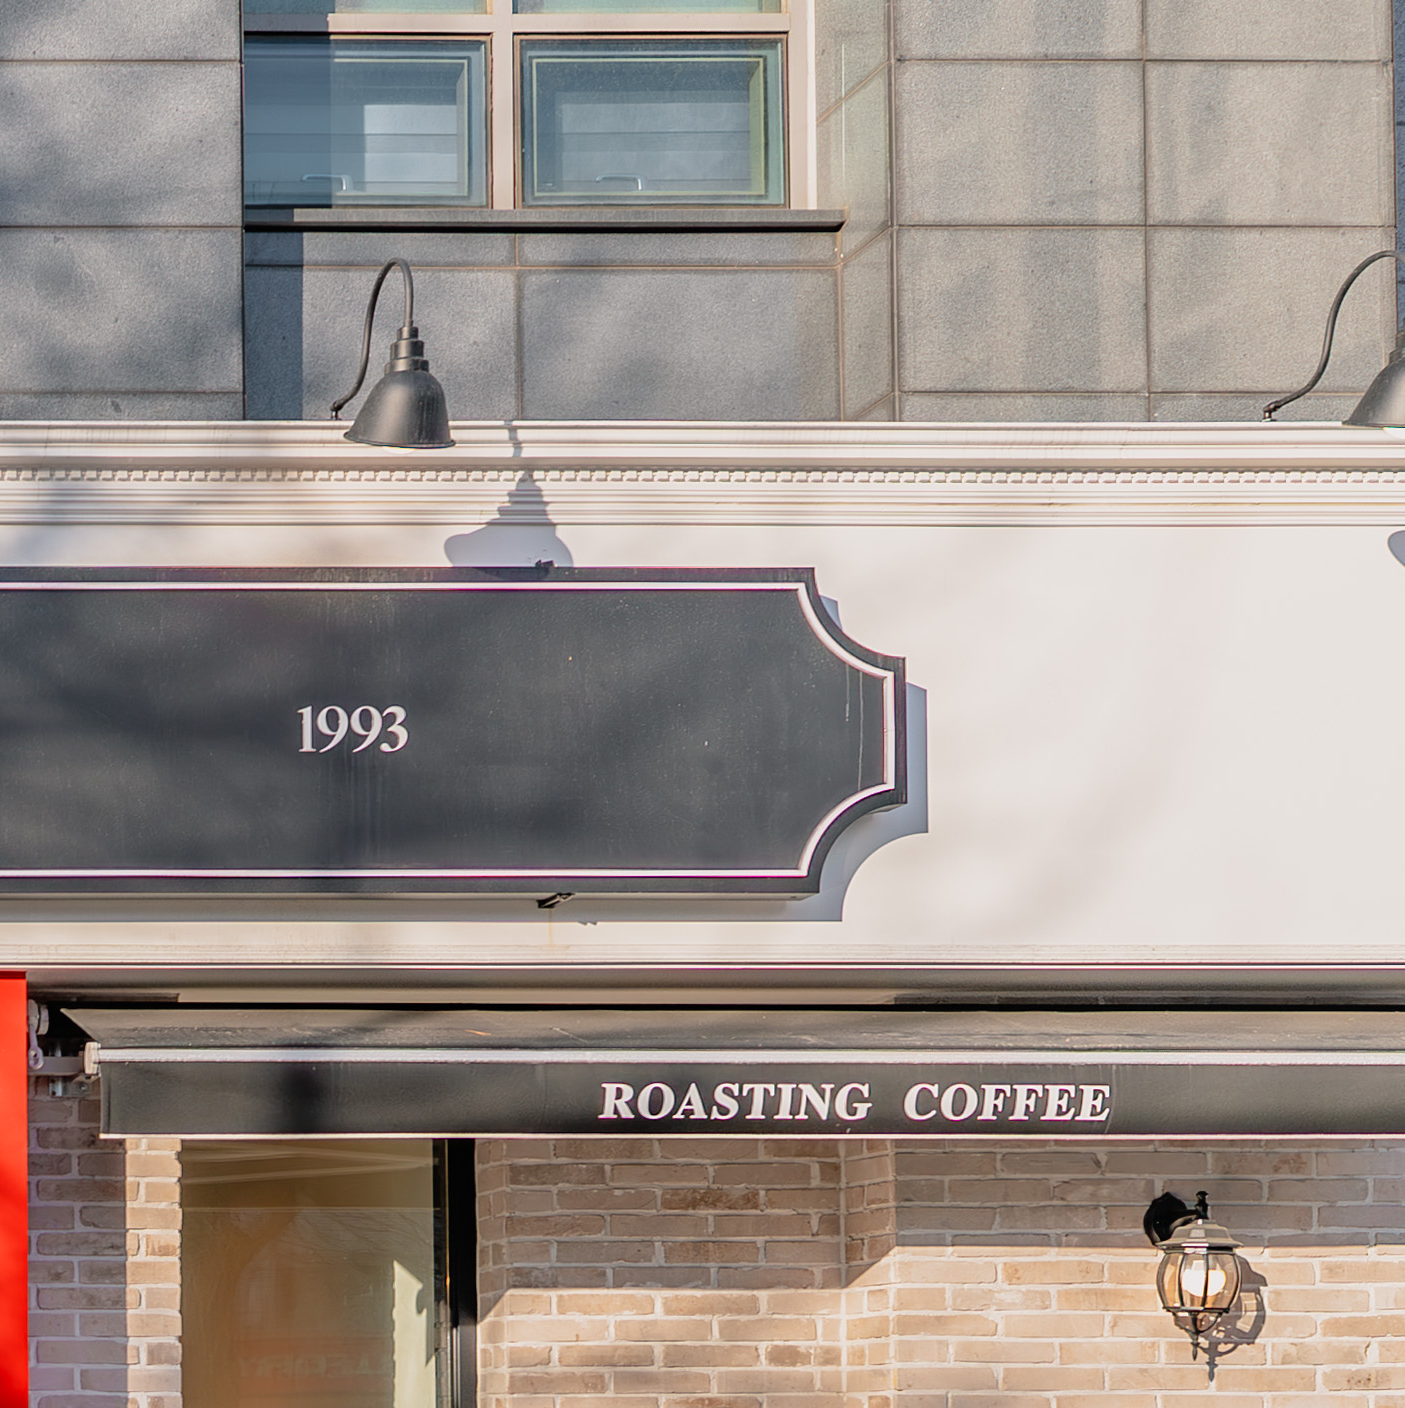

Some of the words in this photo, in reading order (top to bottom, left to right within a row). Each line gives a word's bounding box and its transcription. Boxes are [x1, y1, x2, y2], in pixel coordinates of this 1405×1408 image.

[296, 703, 408, 758] 1993
[596, 1081, 873, 1122] ROASTING
[902, 1083, 1111, 1122] COFFEE
